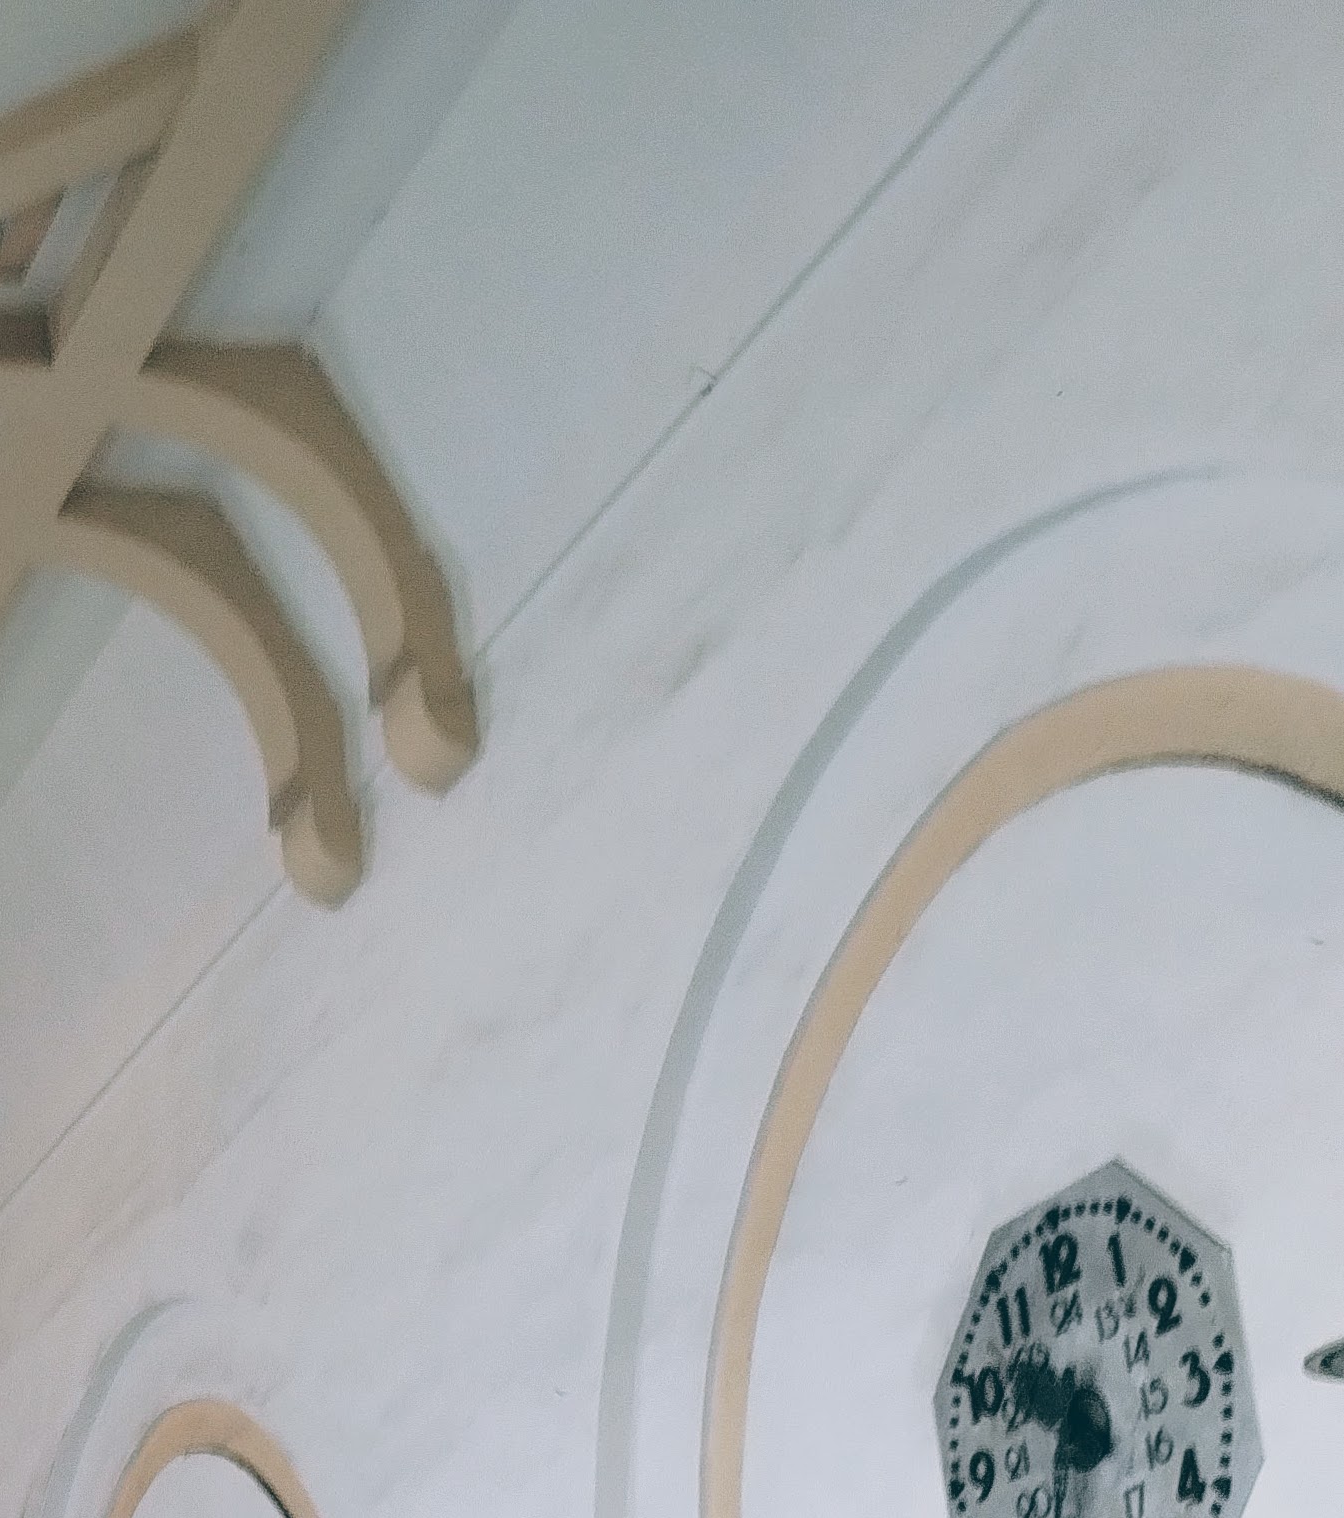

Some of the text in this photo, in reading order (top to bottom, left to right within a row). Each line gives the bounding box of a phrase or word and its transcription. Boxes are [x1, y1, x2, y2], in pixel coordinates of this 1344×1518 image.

[1039, 1233, 1081, 1294] 12
[1108, 1232, 1127, 1288] 1
[996, 1286, 1031, 1346] 11
[1148, 1276, 1182, 1336] 2
[1180, 1349, 1211, 1408] 3
[969, 1450, 995, 1503] 9
[1177, 1446, 1206, 1503] 4
